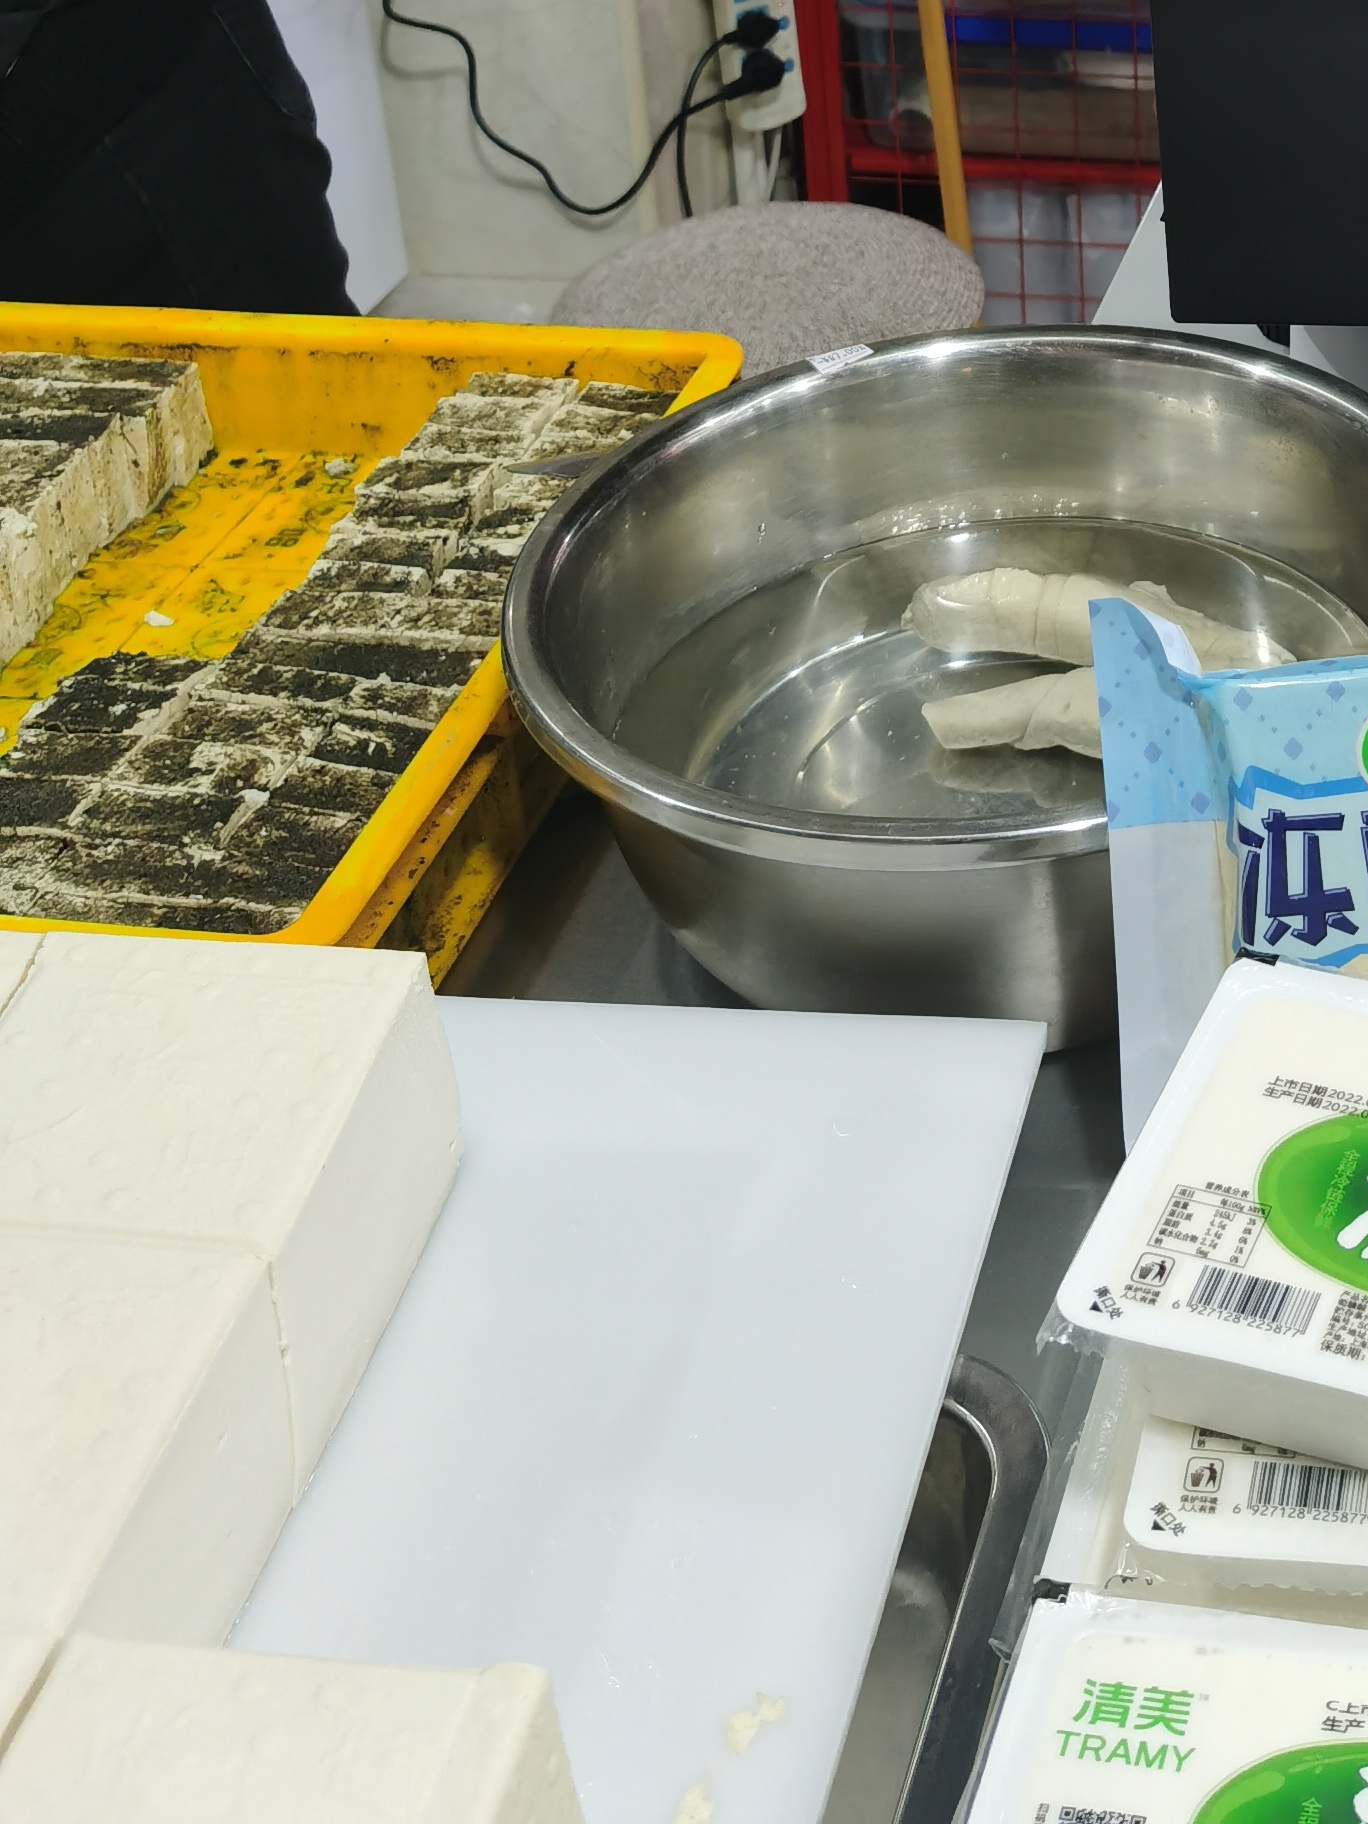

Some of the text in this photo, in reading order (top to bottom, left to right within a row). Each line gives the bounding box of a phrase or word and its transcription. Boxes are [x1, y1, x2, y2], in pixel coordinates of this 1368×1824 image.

[1171, 1299, 1302, 1338] 6 927128 225877
[1232, 1503, 1368, 1525] 6 927128 225877
[1072, 1678, 1196, 1737] 清美
[1320, 1716, 1367, 1735] 生产
[1055, 1728, 1198, 1774] TRAMY
